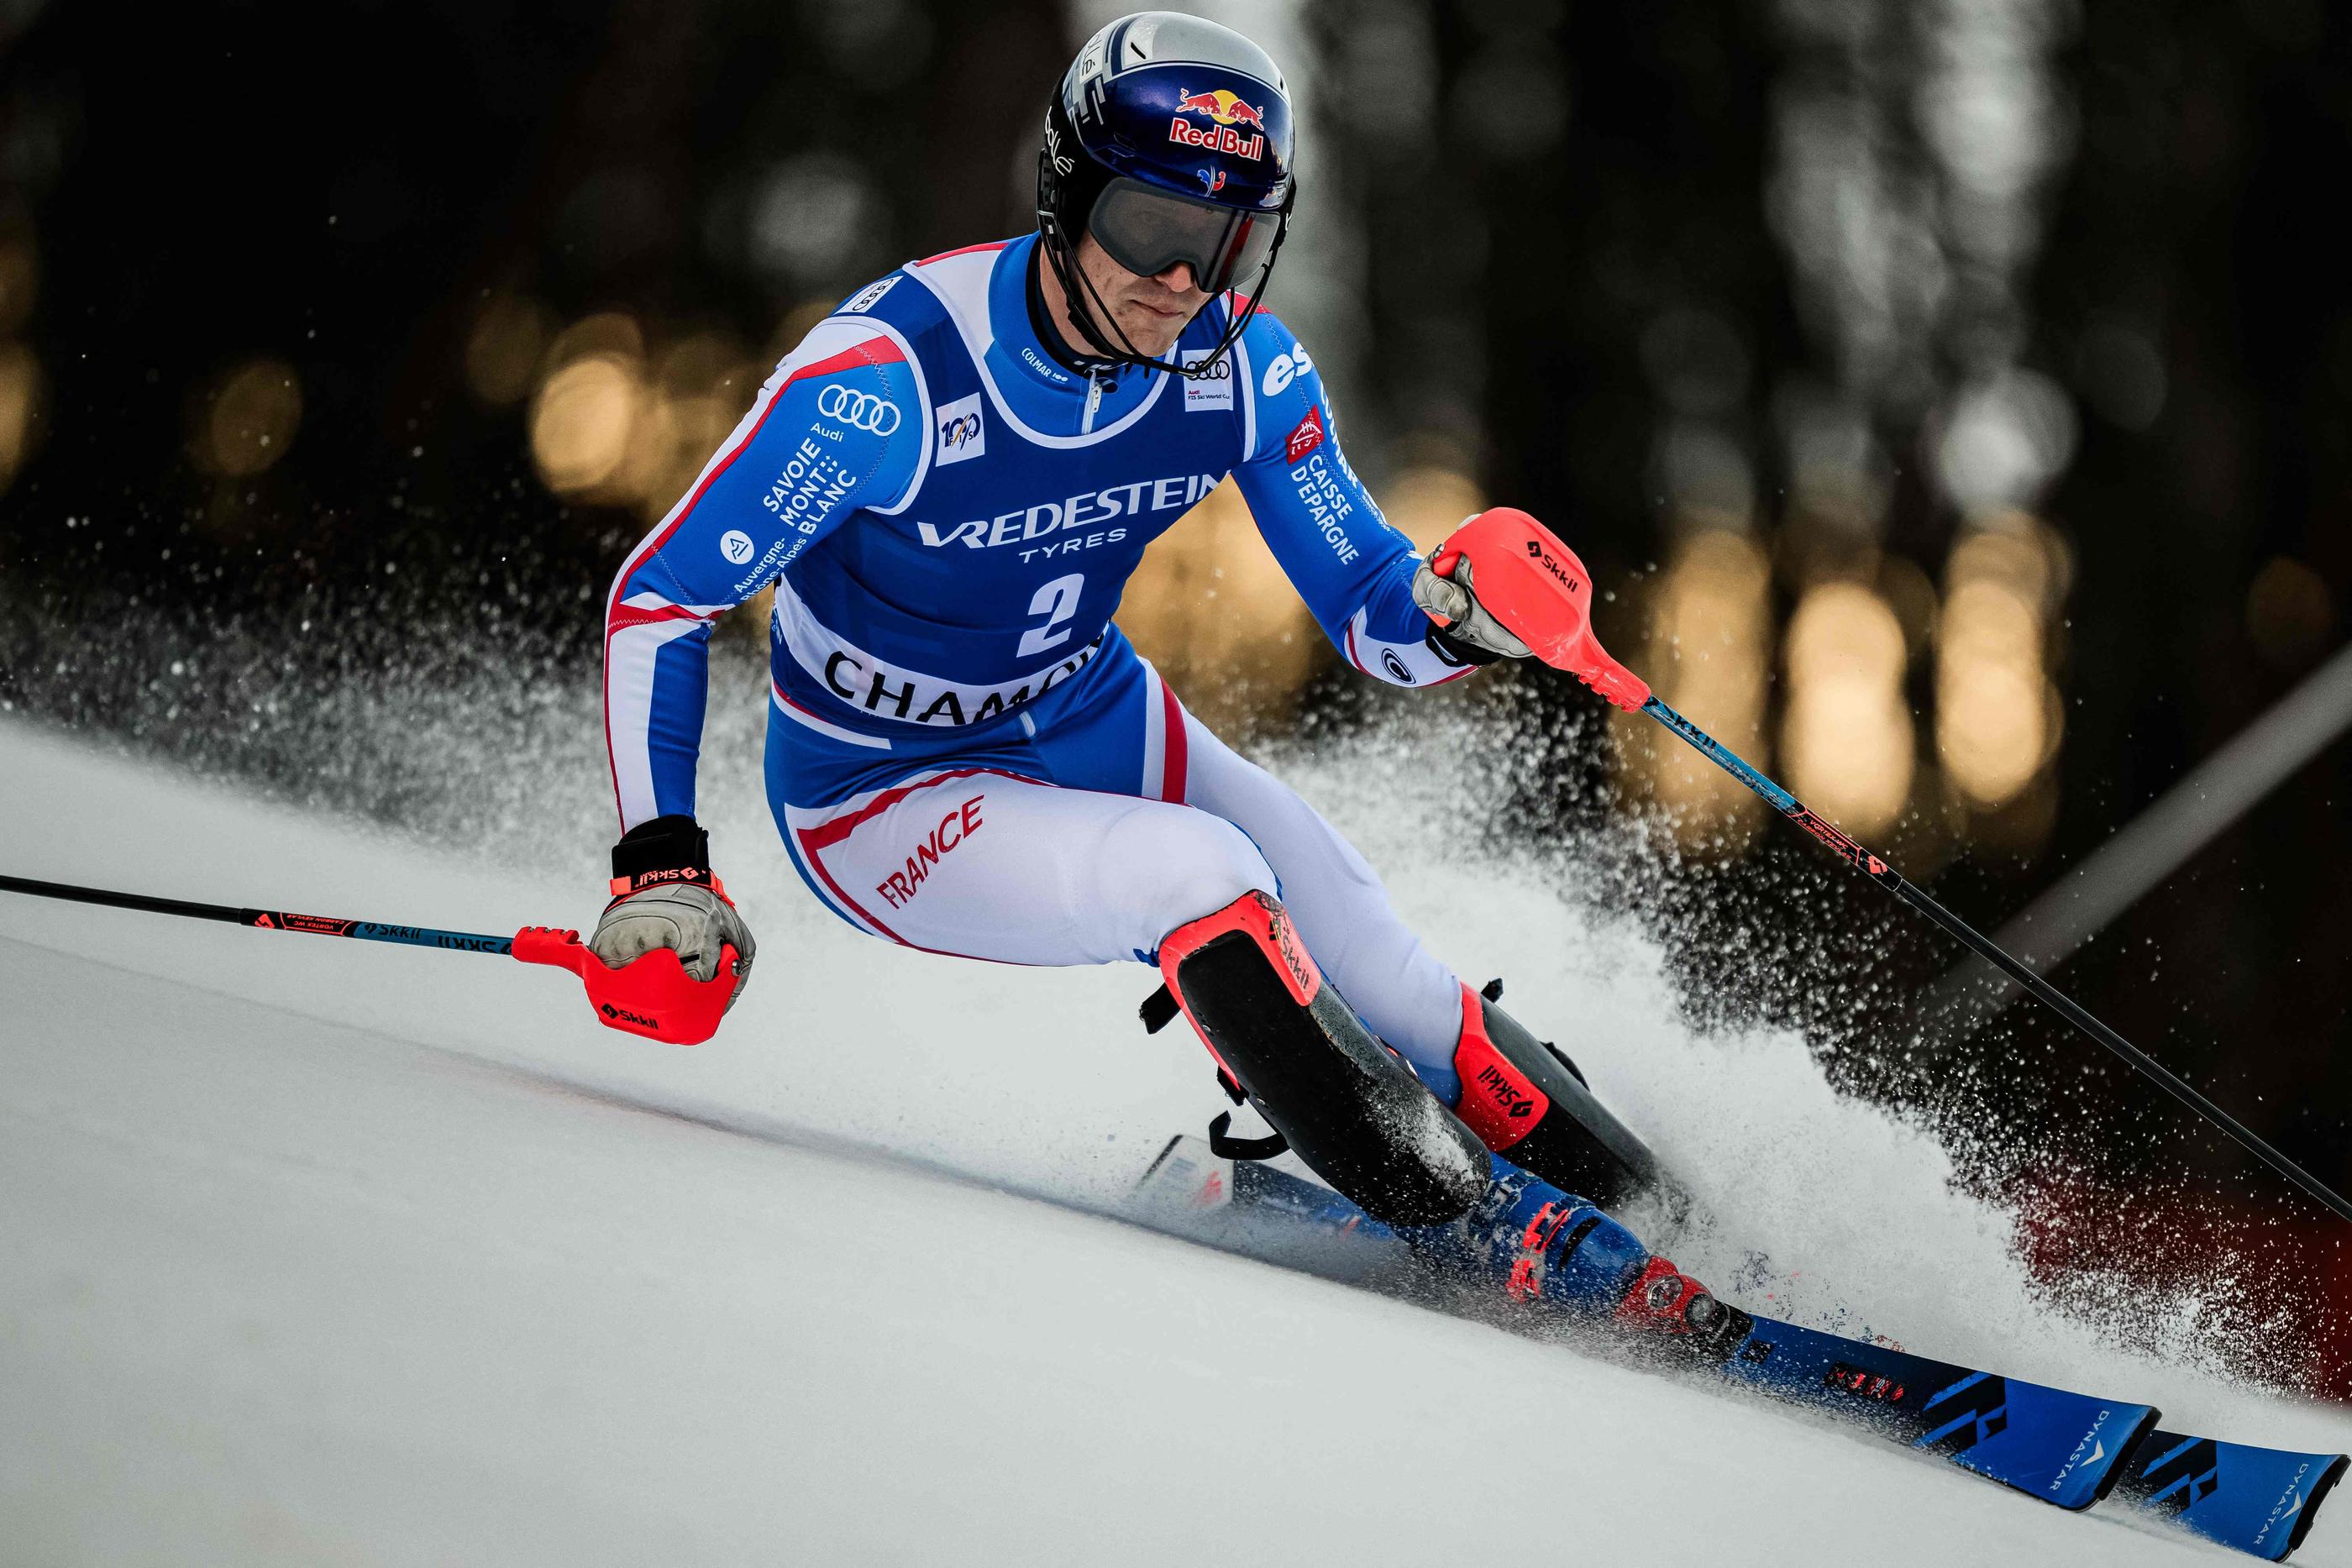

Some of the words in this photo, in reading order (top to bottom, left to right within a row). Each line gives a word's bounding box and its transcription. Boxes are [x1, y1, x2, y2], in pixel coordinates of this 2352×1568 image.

[1169, 118, 1222, 150] Red
[1221, 128, 1263, 161] Bull
[1021, 348, 1052, 377] COLMAR
[1263, 342, 1314, 397] es
[810, 422, 845, 443] Audi
[763, 437, 822, 512] SAVOIE
[779, 466, 827, 527] MONT
[797, 469, 857, 535] BLANC
[1309, 454, 1353, 522] CAISSE
[916, 470, 1231, 549] VREDESTEIN
[1290, 465, 1361, 566] D'EPARGNE
[733, 537, 785, 593] Auvergne-
[1018, 528, 1128, 564] TYRES
[1541, 553, 1578, 593] Skkil
[1016, 573, 1085, 658] 2
[875, 794, 984, 910] FRANCE
[1809, 819, 1836, 839] VORTEX
[638, 869, 680, 886] Skkil
[307, 921, 334, 930] VORTEX
[378, 924, 421, 939] Skkil
[1282, 934, 1310, 990] Skkil
[619, 1009, 659, 1030] Skkil
[1477, 1064, 1522, 1107] Skkil
[2049, 1410, 2110, 1491] DYNASTAR
[2253, 1463, 2310, 1544] DYNASTAR
